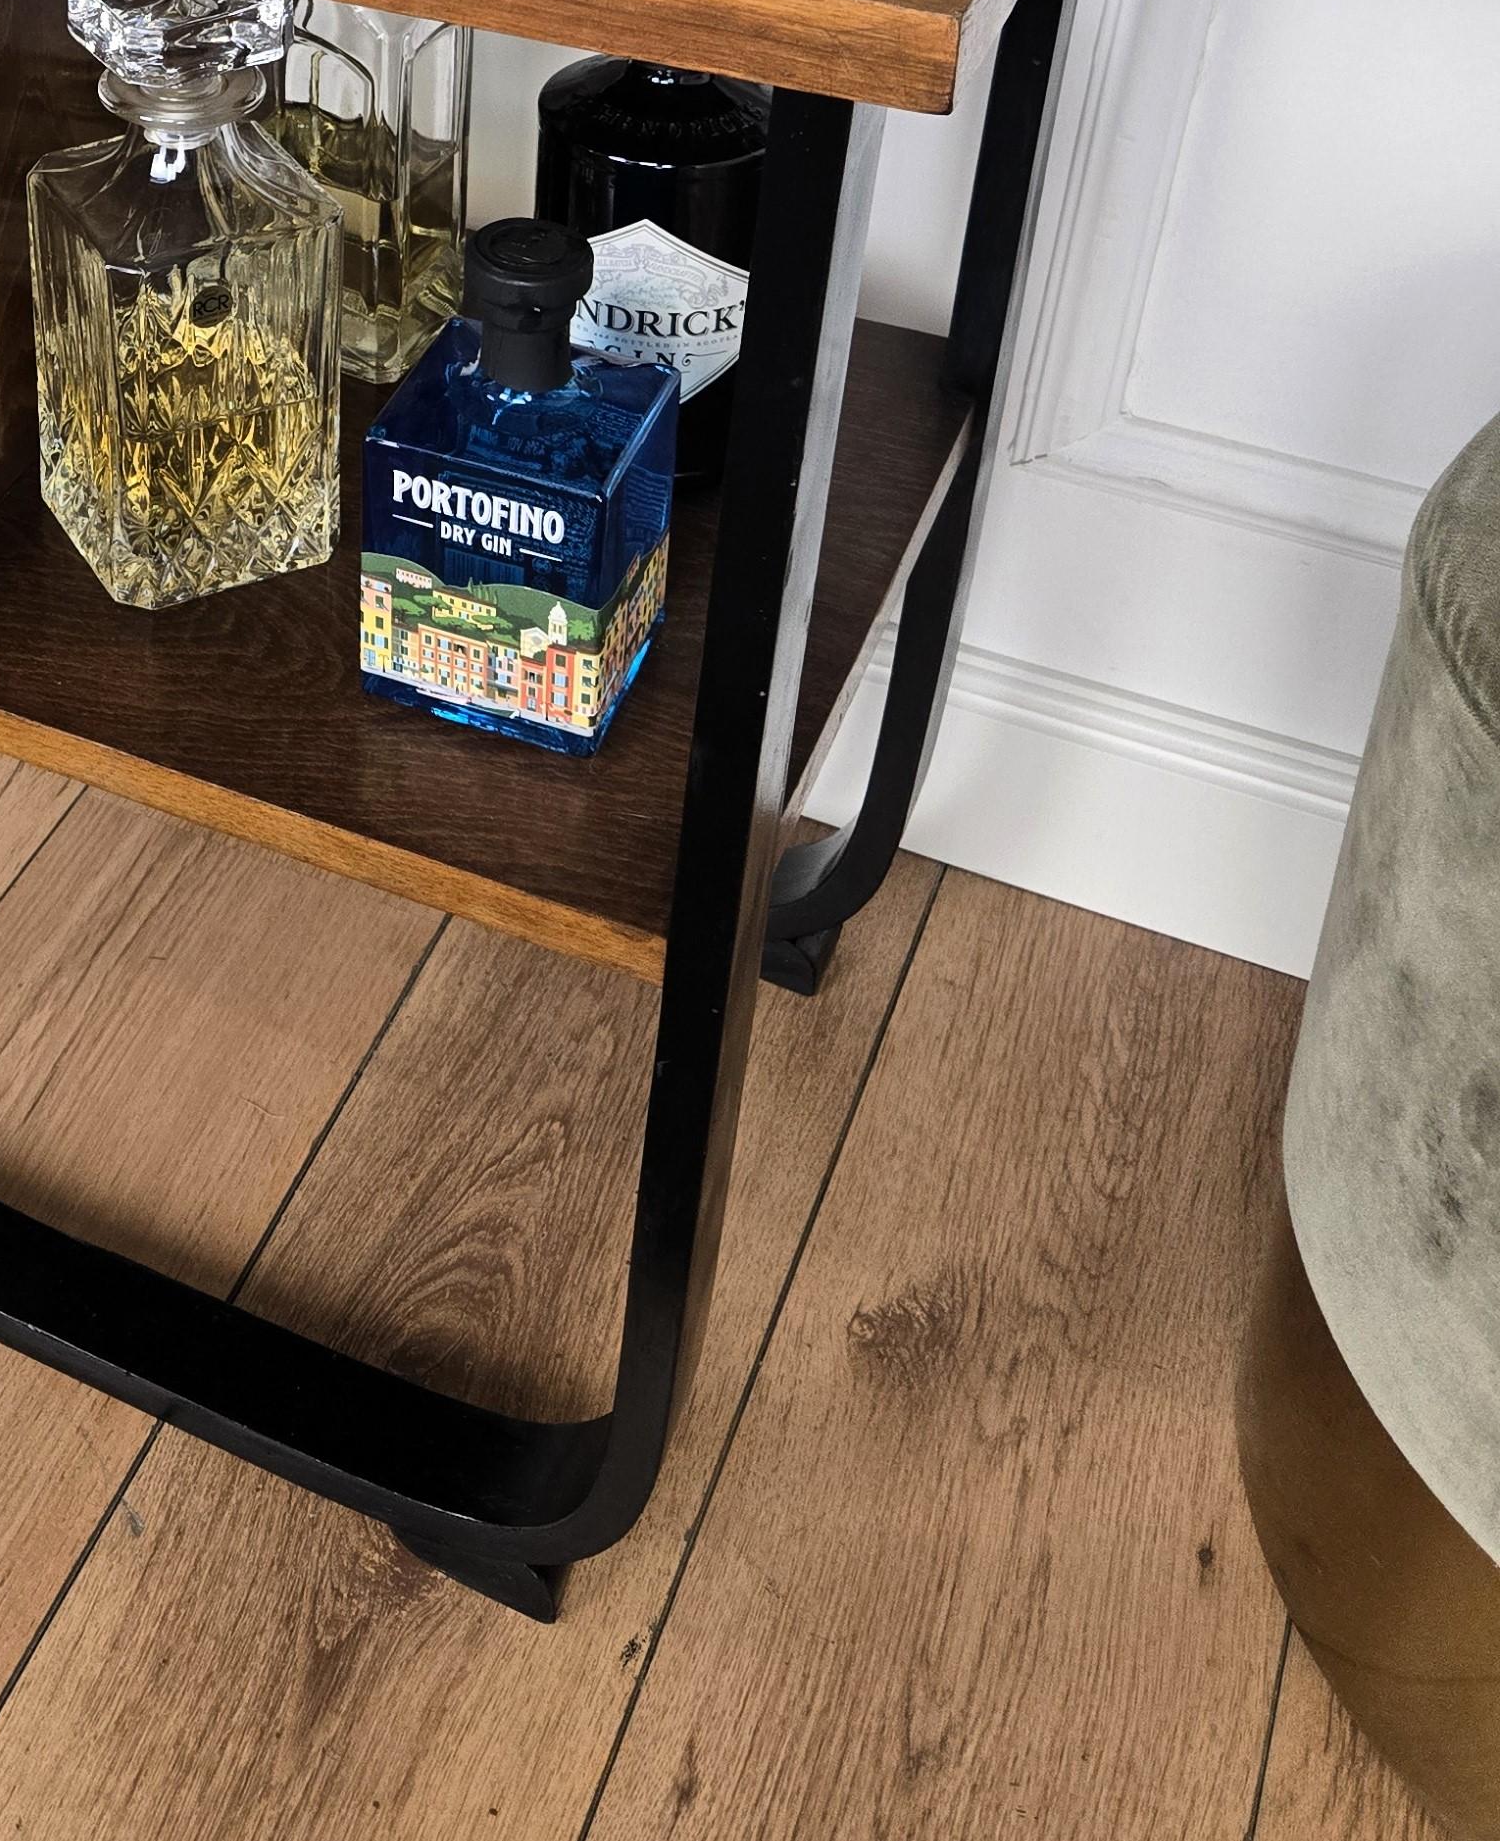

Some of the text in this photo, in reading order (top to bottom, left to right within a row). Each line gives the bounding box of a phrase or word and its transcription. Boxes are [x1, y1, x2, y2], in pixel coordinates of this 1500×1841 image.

[192, 294, 230, 318] RCR
[392, 469, 565, 545] PORTOFINO
[440, 521, 512, 557] DRY GIN
